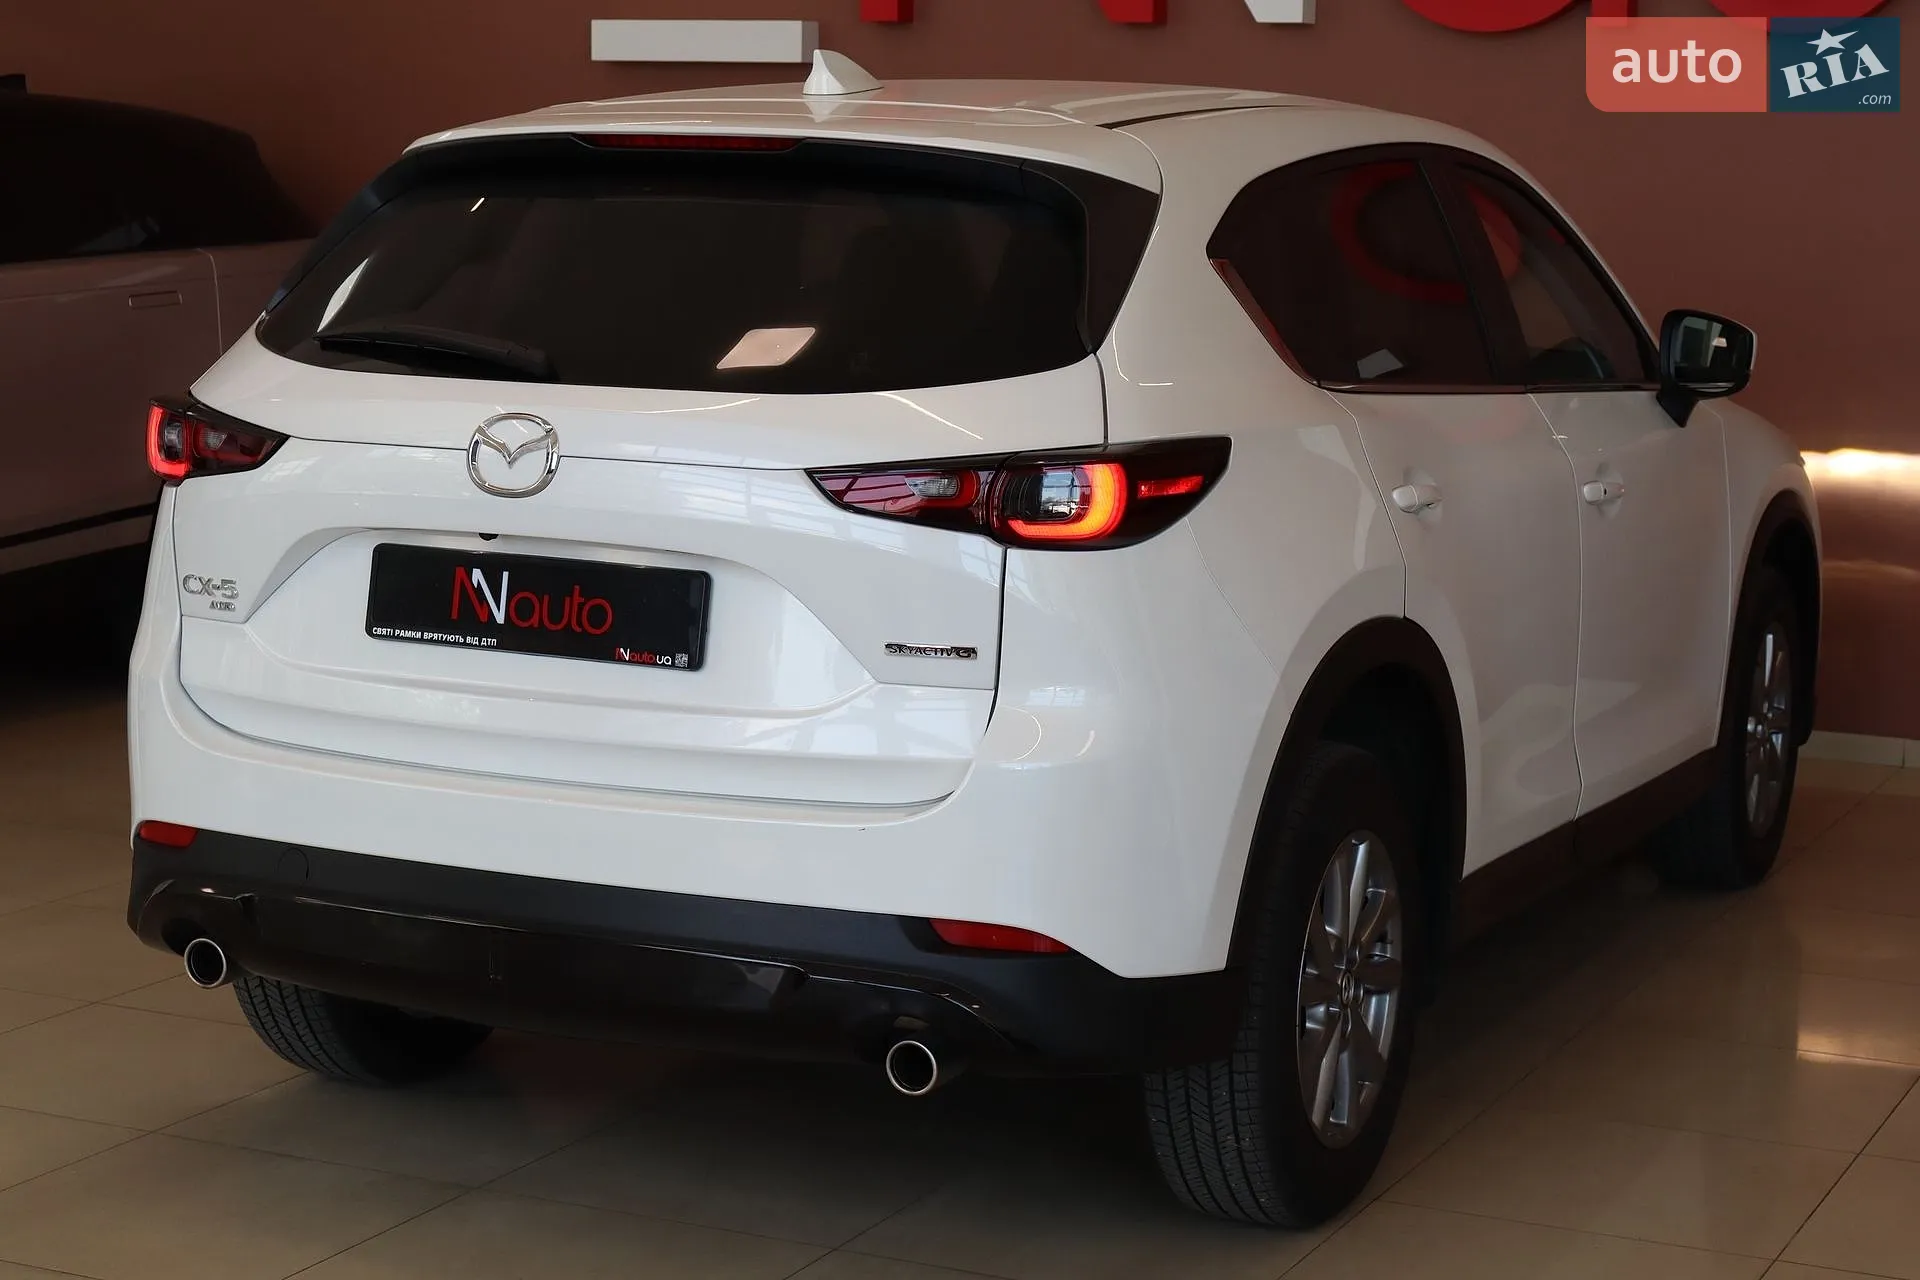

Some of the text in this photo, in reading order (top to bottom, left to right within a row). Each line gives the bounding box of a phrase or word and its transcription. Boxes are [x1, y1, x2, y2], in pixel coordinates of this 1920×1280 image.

[182, 574, 239, 599] CX-5
[372, 626, 497, 646] СВЯТІ РАМКИ ВРЯТУЮТЬ ВІД ДТП
